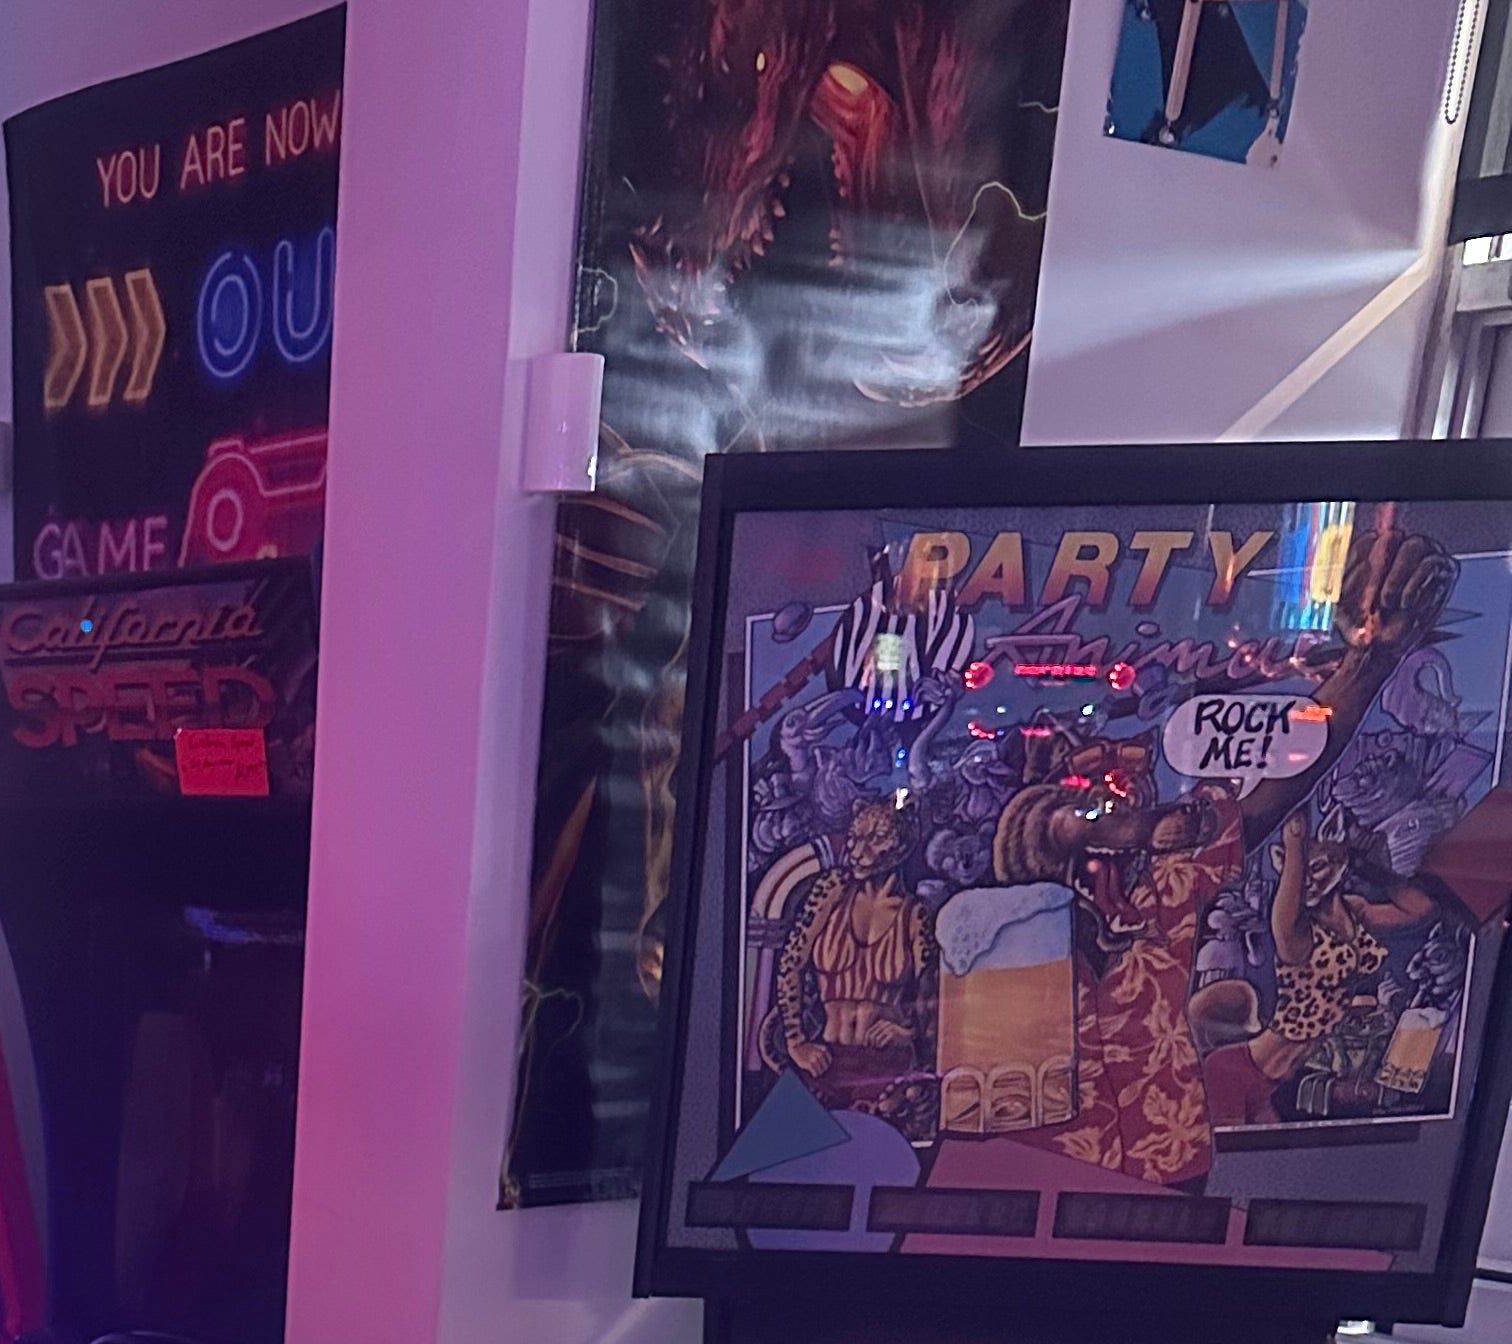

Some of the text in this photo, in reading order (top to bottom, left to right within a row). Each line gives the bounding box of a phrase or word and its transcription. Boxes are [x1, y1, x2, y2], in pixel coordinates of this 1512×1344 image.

[97, 90, 342, 207] YOU ARE NOW
[198, 226, 334, 379] OU
[895, 530, 1276, 612] PARTY
[0, 597, 265, 672] California
[7, 667, 276, 748] SPEED
[1194, 700, 1291, 737] ROCK
[1200, 739, 1274, 770] ME!
